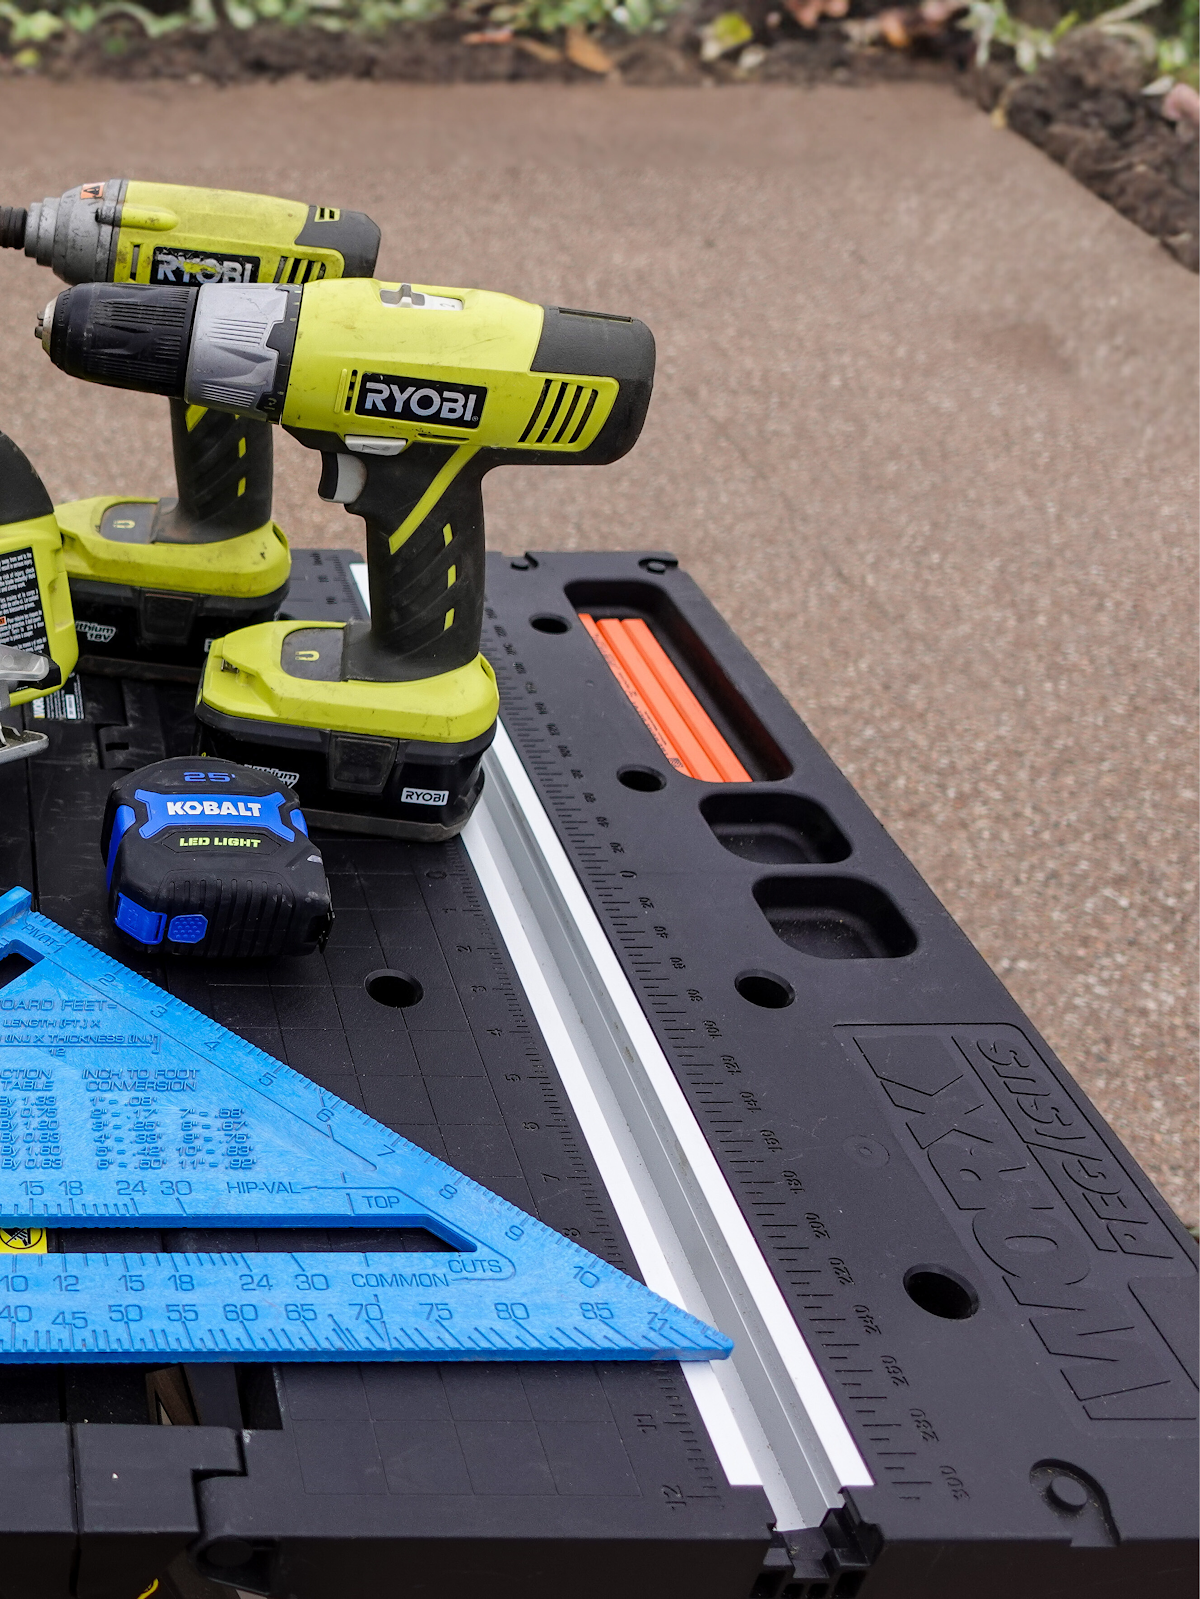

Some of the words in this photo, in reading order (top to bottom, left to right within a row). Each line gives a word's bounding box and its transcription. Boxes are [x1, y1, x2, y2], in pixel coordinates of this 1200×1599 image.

[156, 252, 253, 284] RYOBI
[405, 791, 445, 802] RYOBI
[166, 801, 261, 817] KOBALT
[180, 837, 211, 847] LED
[214, 838, 261, 848] LIGHT
[3, 1019, 56, 1028] LENGTH
[48, 1035, 125, 1044] THICKNESS
[48, 1047, 66, 1057] 12
[81, 1068, 123, 1080] INCH
[127, 1069, 150, 1080] TO
[154, 1069, 200, 1080] FOOT
[2, 1080, 55, 1091] TABLE
[85, 1080, 198, 1092] CONVERSION
[21, 924, 57, 947] PIVOT
[98, 973, 116, 986] 2
[150, 1005, 168, 1019] 3
[204, 1041, 221, 1051] 4
[258, 1072, 277, 1087] 5
[316, 1110, 335, 1123] 6
[377, 1144, 395, 1157] 7
[439, 1184, 458, 1200] 8
[505, 1225, 525, 1241] 9
[573, 1265, 600, 1288] 10
[647, 1311, 668, 1332] 11
[975, 1039, 1174, 1260] PEGASUS
[19, 1180, 45, 1196] 15
[58, 1180, 84, 1196] 18
[115, 1180, 148, 1196] 24
[159, 1180, 193, 1196] 30
[226, 1181, 301, 1194] HIP-VAL
[362, 1195, 400, 1209] TOP
[878, 1074, 1171, 1400] WORX
[805, 1212, 831, 1239] 200
[828, 1257, 855, 1285] 220
[448, 1259, 502, 1273] CUTS
[0, 1275, 29, 1292] 10
[52, 1274, 80, 1292] 12
[118, 1274, 145, 1291] 15
[167, 1274, 195, 1291] 18
[239, 1274, 273, 1291] 24
[294, 1274, 330, 1291] 30
[351, 1273, 449, 1288] COMMON
[52, 1311, 88, 1329] 45
[107, 1304, 143, 1322] 50
[165, 1304, 199, 1322] 55
[223, 1304, 258, 1321] 60
[284, 1303, 318, 1321] 65
[349, 1303, 384, 1321] 70
[419, 1303, 453, 1320] 75
[494, 1302, 530, 1320] 80
[579, 1302, 614, 1320] 85
